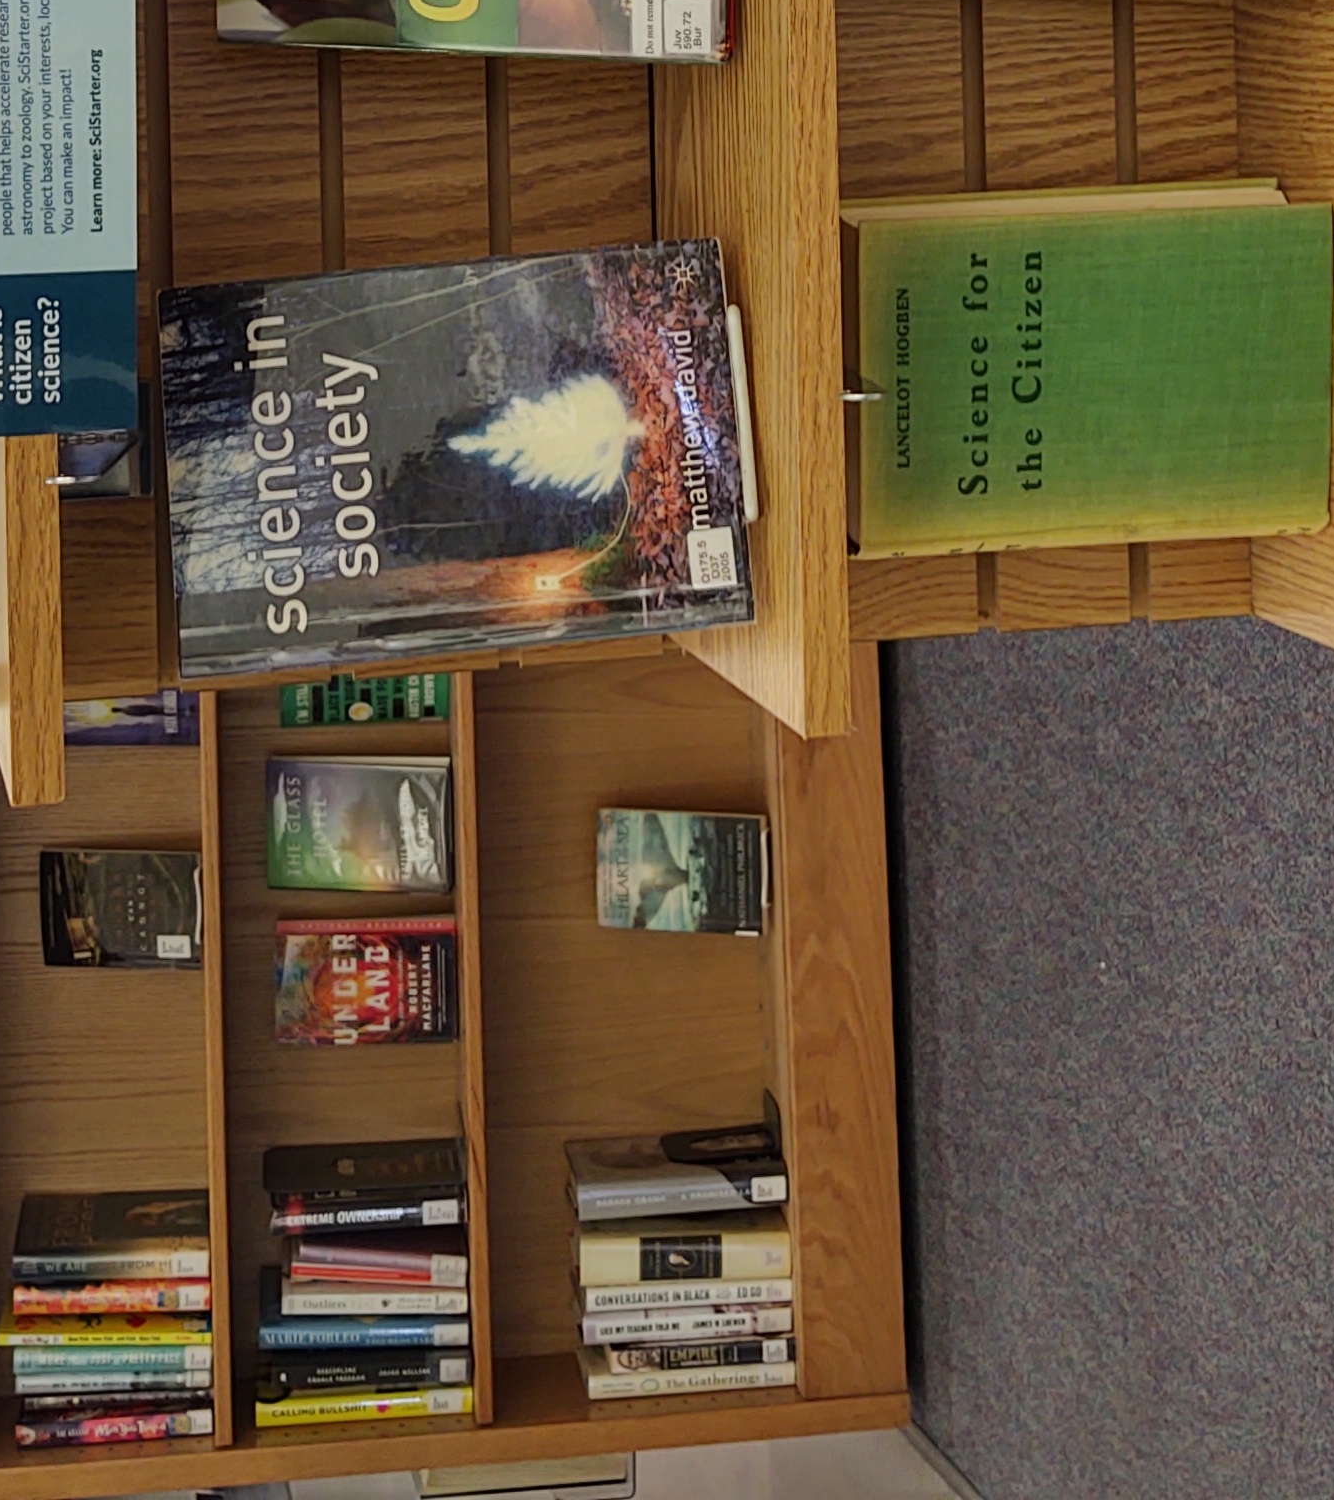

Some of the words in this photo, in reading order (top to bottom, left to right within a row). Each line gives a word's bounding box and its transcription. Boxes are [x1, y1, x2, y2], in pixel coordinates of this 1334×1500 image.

[673, 29, 682, 49] Juv
[683, 11, 692, 49] 590.72
[88, 49, 104, 146] SciStarter.org
[91, 149, 103, 190] more:
[90, 193, 103, 233] Learn
[962, 253, 988, 311] for
[9, 319, 33, 405] citizen
[37, 296, 61, 403] science?
[233, 315, 289, 371] in
[667, 328, 700, 398] david
[895, 288, 910, 366] HOGBEN
[1012, 250, 1042, 405] Citizen
[896, 375, 910, 469] LANCELOT
[958, 335, 989, 496] Science
[314, 352, 380, 578] society
[681, 411, 711, 531] matthew
[1017, 427, 1042, 491] the
[248, 390, 308, 634] science
[286, 776, 301, 833] GLASS
[286, 844, 301, 876] THE
[331, 934, 359, 1045] UNDER
[365, 945, 391, 1031] LAND
